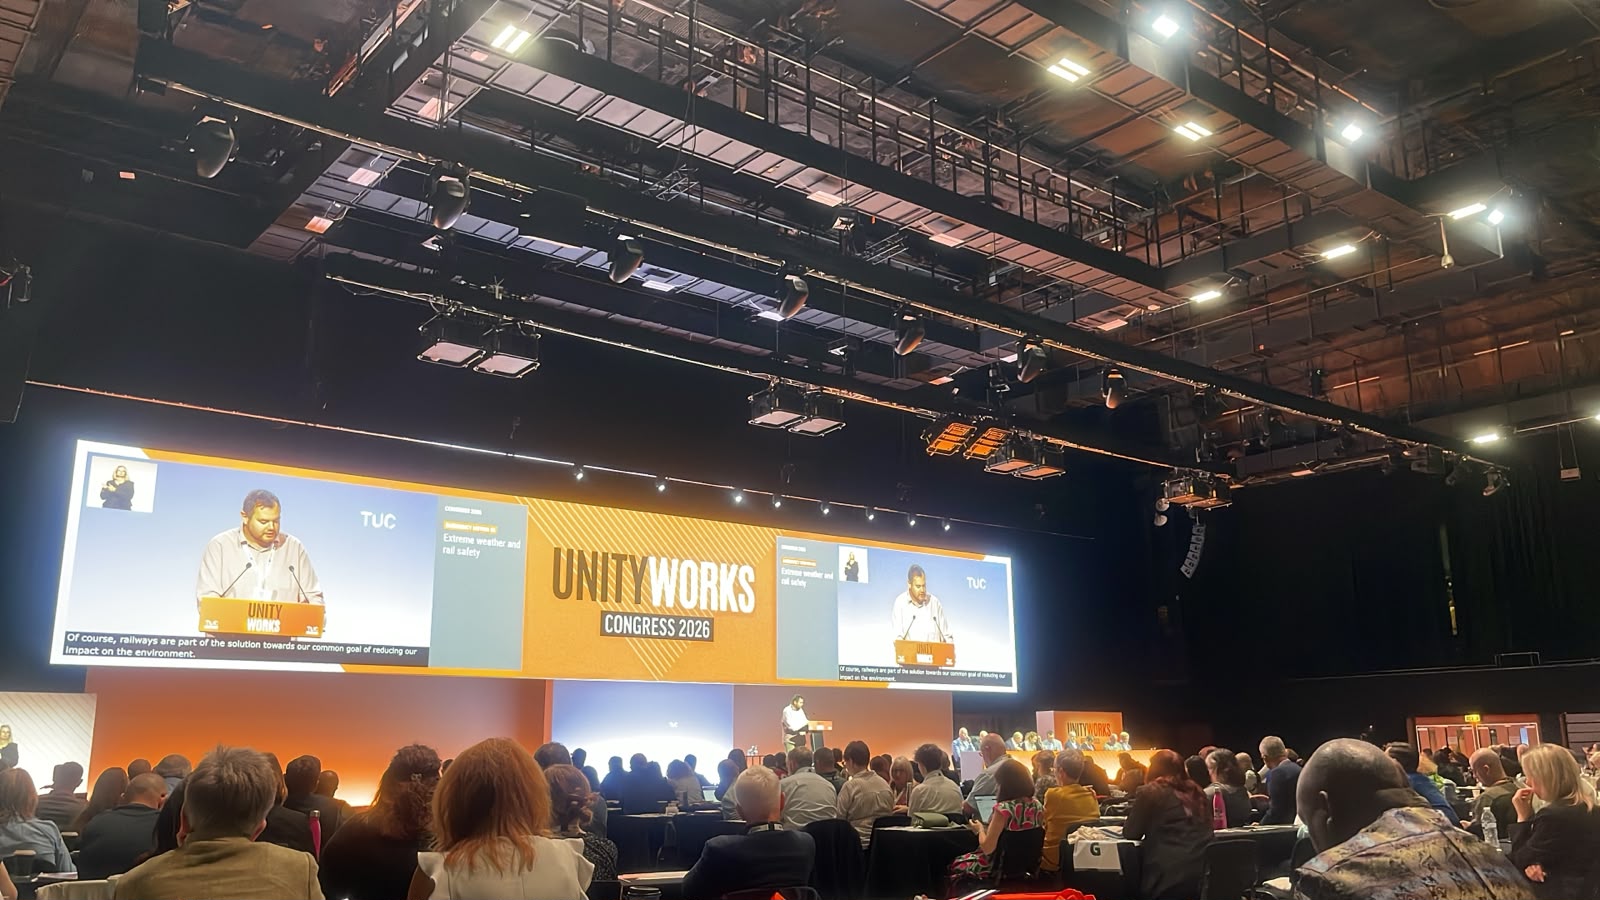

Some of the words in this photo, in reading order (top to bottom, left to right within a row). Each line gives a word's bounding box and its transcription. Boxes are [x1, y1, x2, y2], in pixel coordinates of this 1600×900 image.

[359, 510, 397, 530] TUC
[443, 533, 474, 544] Extreme
[476, 537, 506, 547] weather
[508, 539, 521, 549] and
[442, 546, 455, 555] rail
[456, 547, 480, 559] safety
[552, 546, 755, 614] UNITYWORKS
[966, 573, 987, 590] TUC
[248, 602, 283, 619] UNITY
[247, 618, 281, 633] WORKS
[604, 614, 675, 637] CONGRESS
[678, 619, 710, 639] 2026
[67, 633, 79, 641] Of
[81, 635, 117, 644] course,
[119, 636, 158, 646] railways
[160, 638, 176, 646] are
[178, 638, 197, 648] part
[199, 638, 209, 646] of
[210, 638, 226, 647] the
[227, 639, 261, 649] solution
[263, 642, 295, 650] towards
[346, 645, 362, 654] goal
[372, 646, 403, 656] reducing
[101, 648, 114, 656] on
[116, 647, 133, 656] the
[134, 649, 196, 658] environment.
[1090, 842, 1102, 856] G
